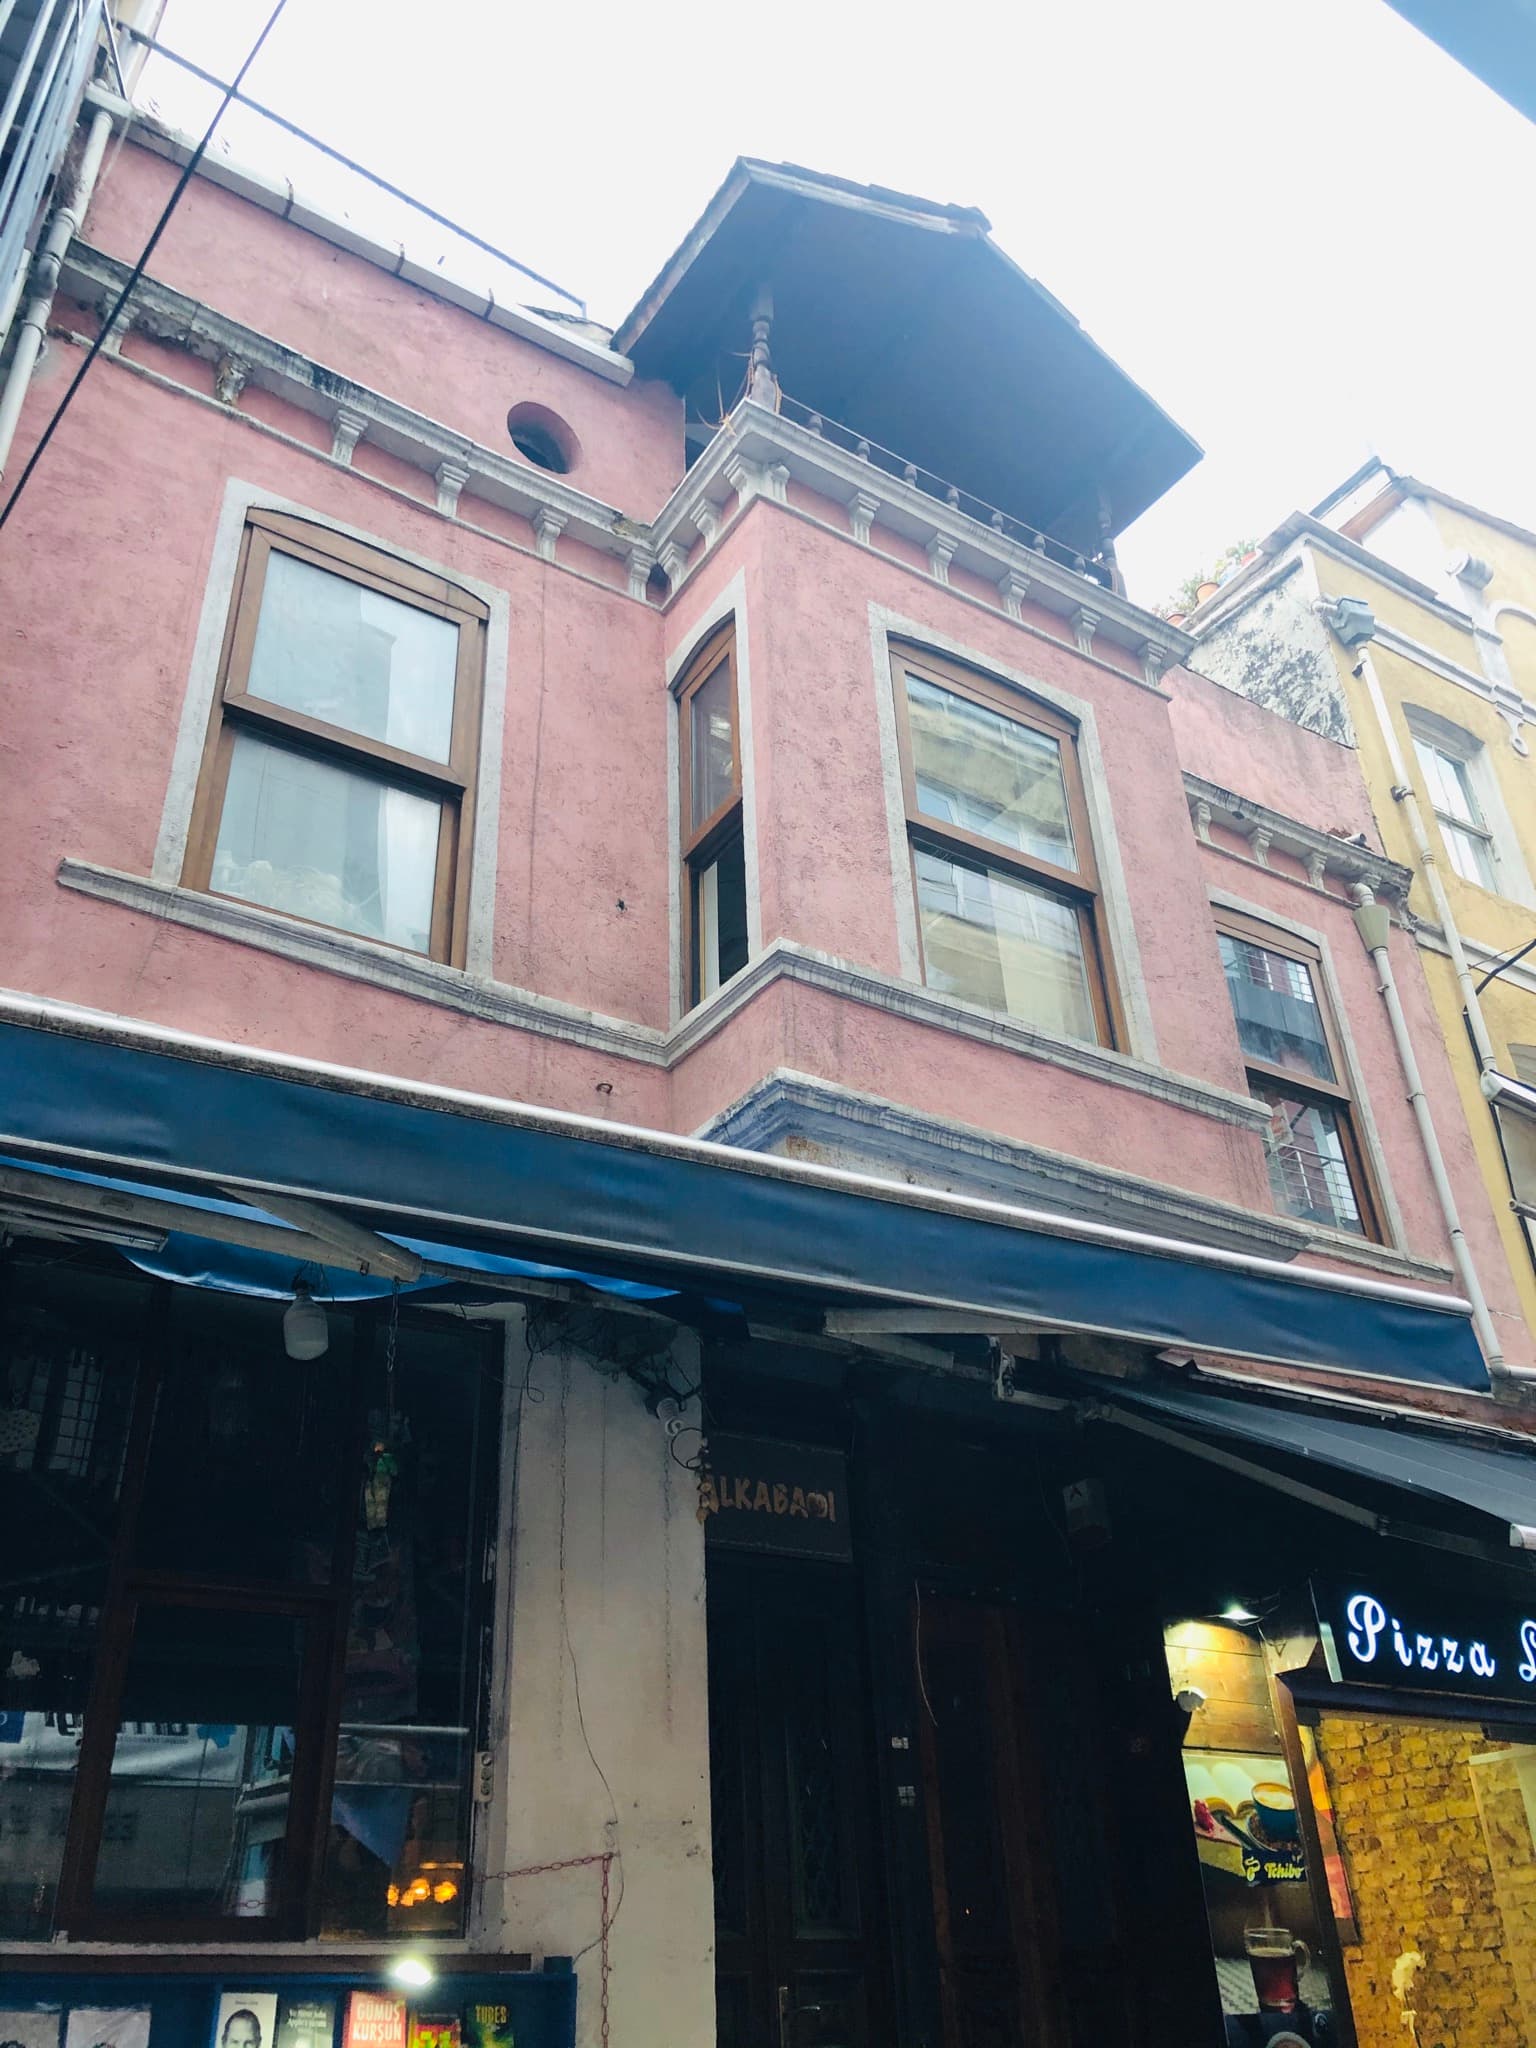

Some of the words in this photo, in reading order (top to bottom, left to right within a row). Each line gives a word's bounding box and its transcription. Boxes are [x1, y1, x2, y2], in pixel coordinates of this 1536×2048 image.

[1347, 1595, 1495, 1678] Pizza
[1264, 1861, 1305, 1879] Tchibo
[352, 2021, 402, 2043] KURŞUN
